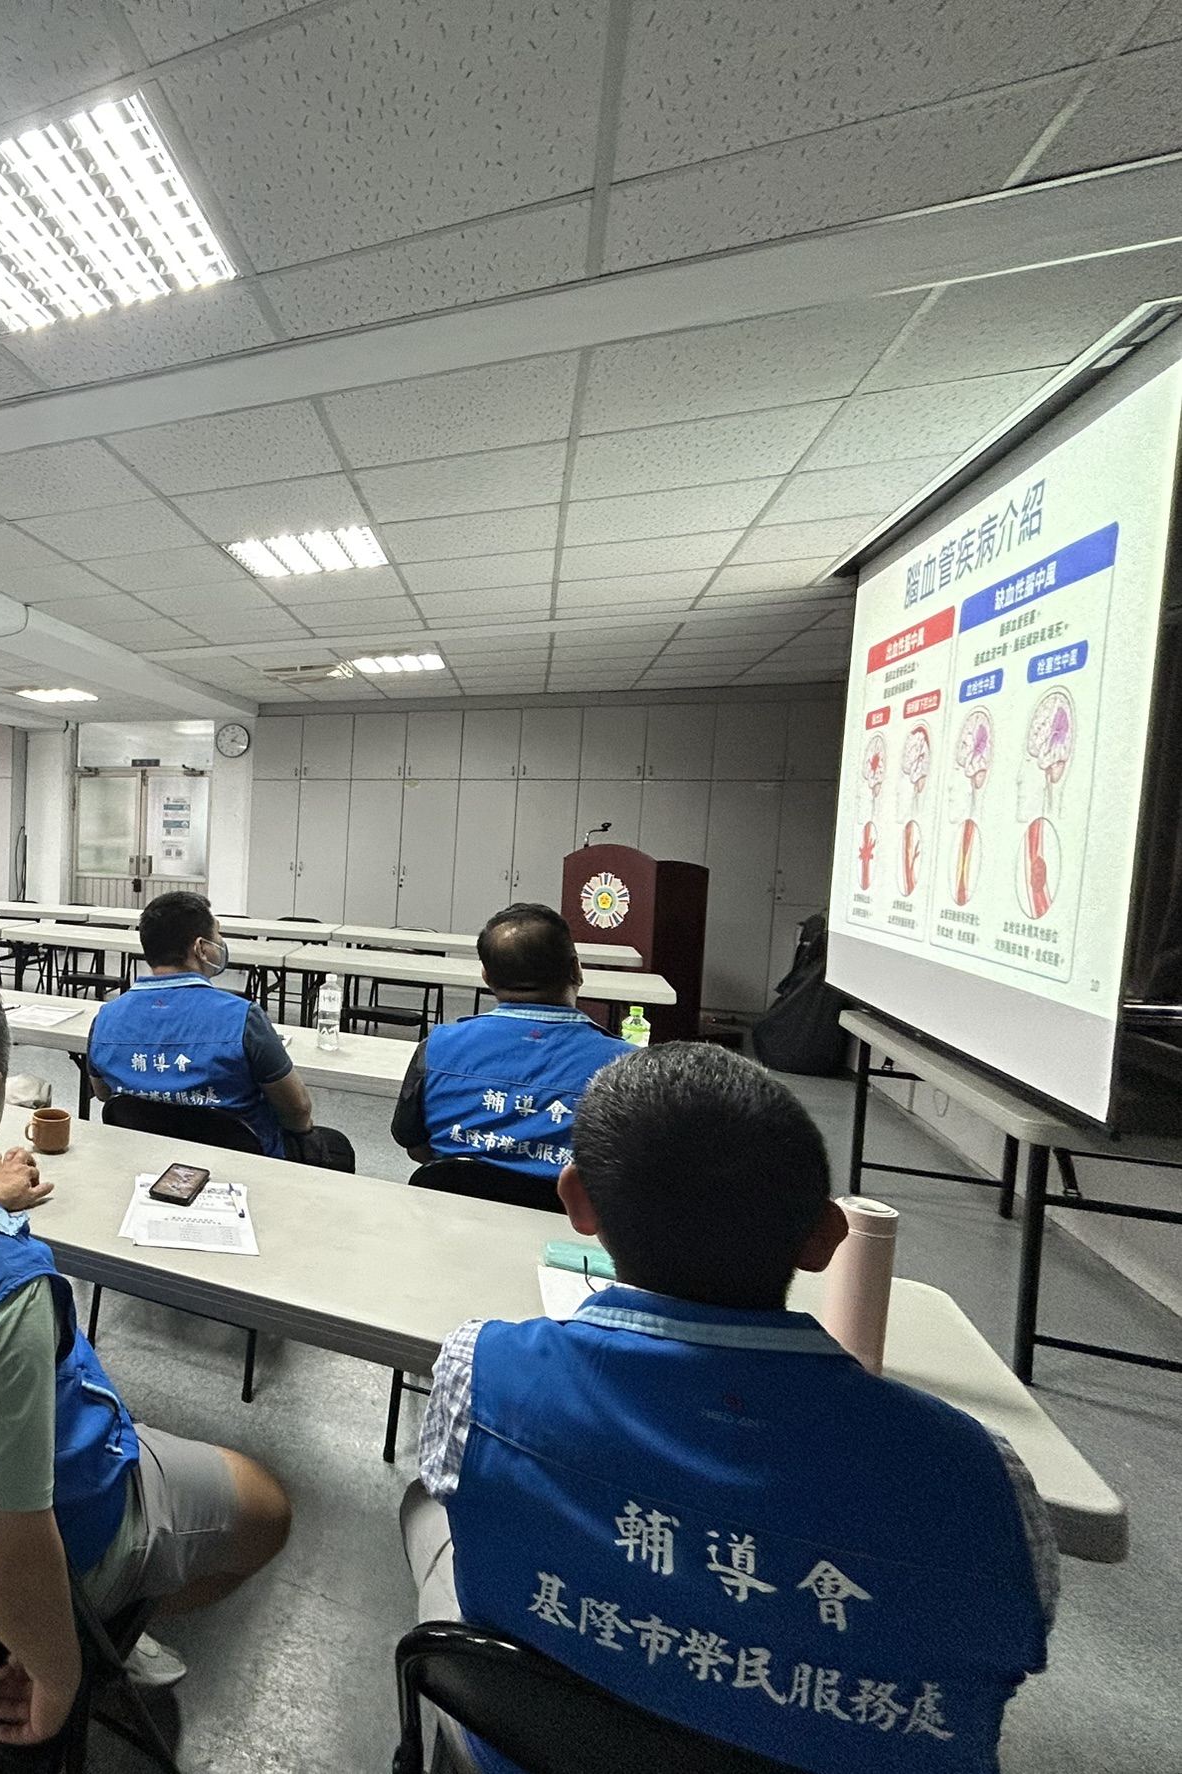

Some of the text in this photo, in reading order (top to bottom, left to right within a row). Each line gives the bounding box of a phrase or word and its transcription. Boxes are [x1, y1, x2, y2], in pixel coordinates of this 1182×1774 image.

[904, 479, 1046, 610] 腦血管疾病介紹
[994, 561, 1057, 610] 缺血性腦中風
[131, 1053, 192, 1073] 輔導會
[117, 1086, 221, 1105] 榮民服務處
[482, 1089, 573, 1124] 輔導會
[449, 1124, 575, 1165] 基隆市榮民服務
[615, 1500, 873, 1632] 輔導會
[528, 1571, 955, 1741] 基隆市榮民服務處
